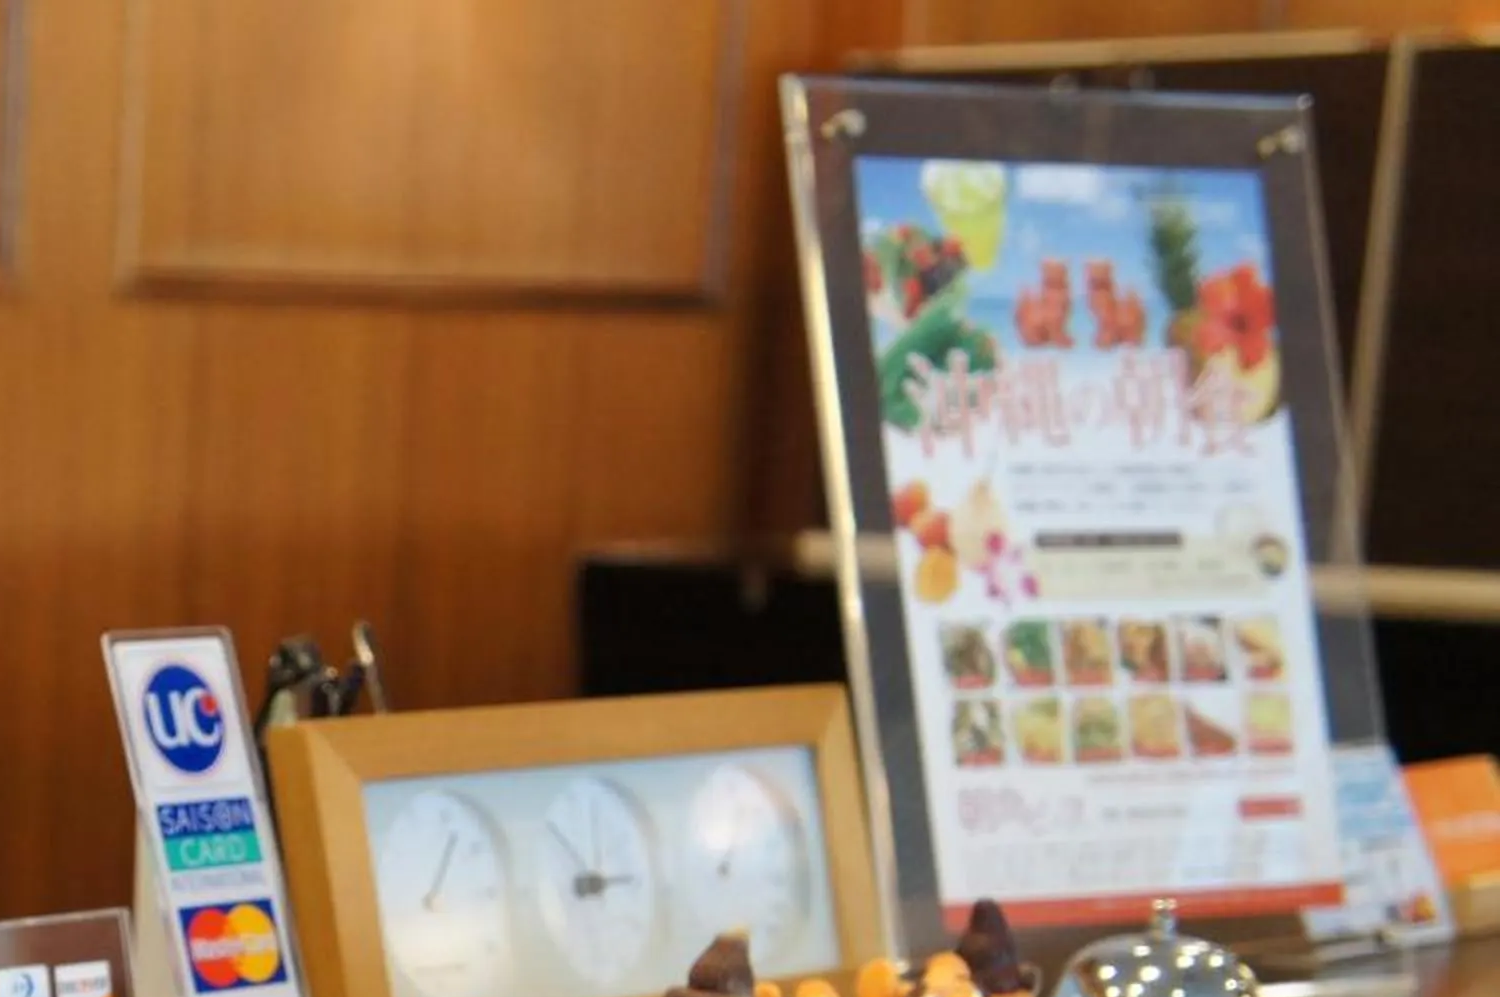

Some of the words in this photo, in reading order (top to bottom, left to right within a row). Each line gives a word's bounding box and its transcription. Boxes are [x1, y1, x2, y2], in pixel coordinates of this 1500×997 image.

[145, 686, 222, 749] UC
[158, 799, 253, 835] SAISON
[179, 832, 247, 867] CARD
